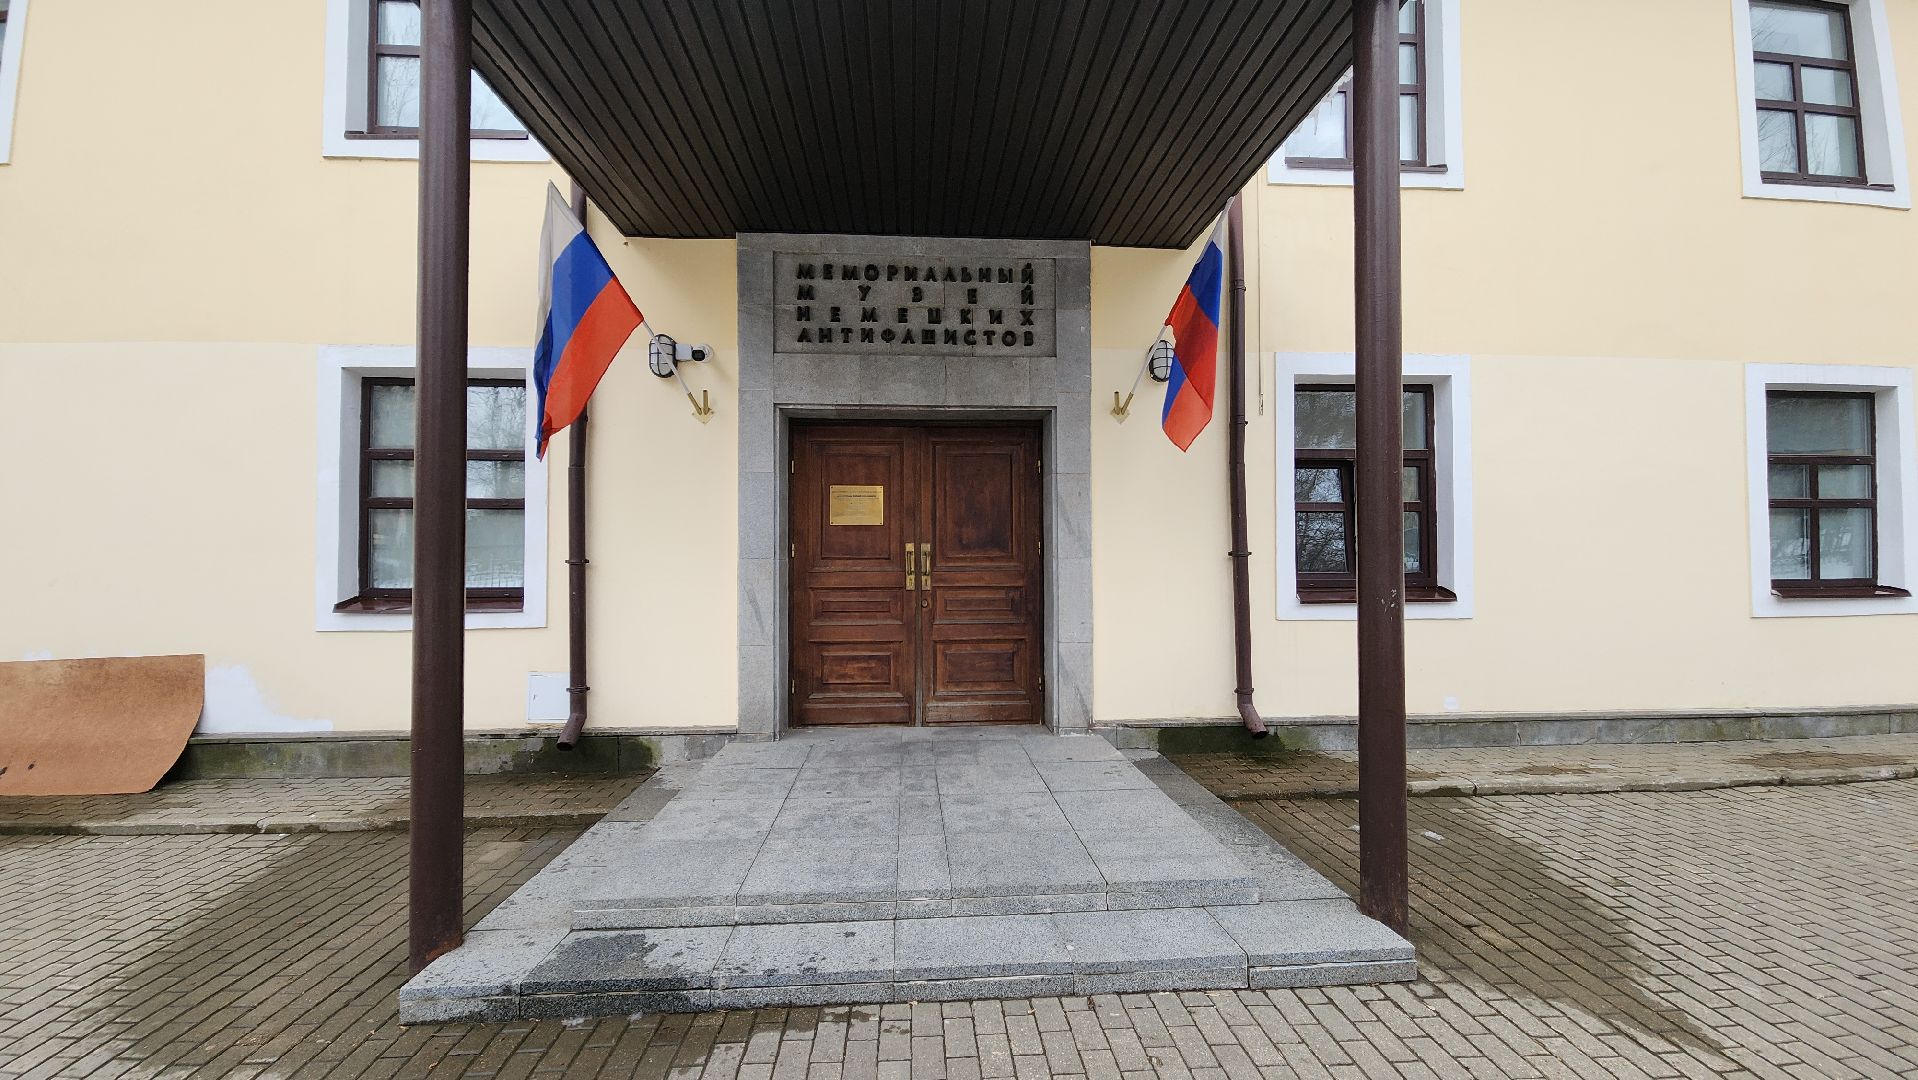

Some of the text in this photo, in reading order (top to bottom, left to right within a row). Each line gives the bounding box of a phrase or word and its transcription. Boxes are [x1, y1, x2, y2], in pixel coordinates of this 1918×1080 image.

[796, 263, 1034, 284] МЕМОРИАЛЬНЫЙ
[796, 284, 1034, 305] МУЗЕЙ
[796, 306, 1034, 326] НЕМЕЦКИХ
[796, 327, 1034, 347] АНТИФАШИСТОВ
